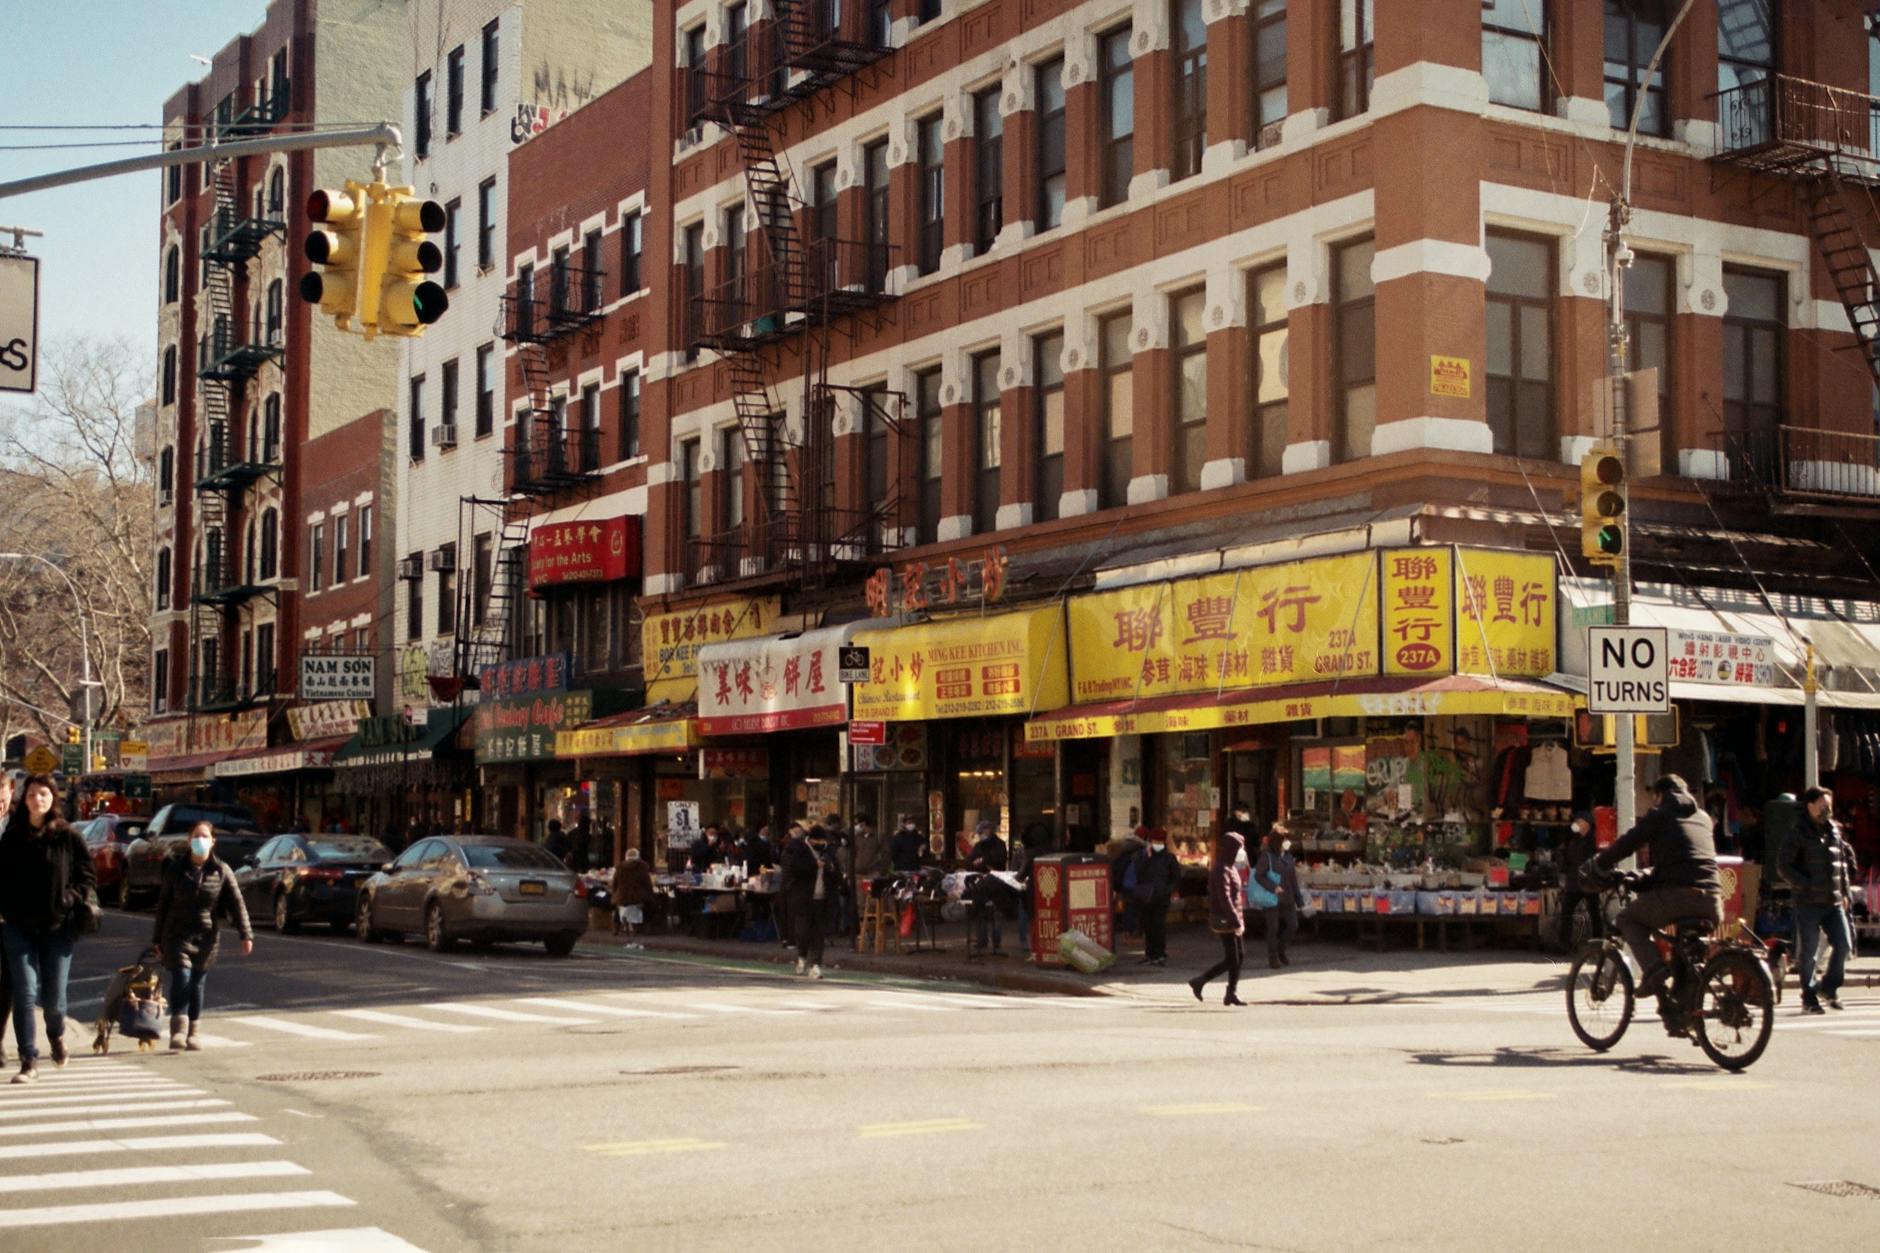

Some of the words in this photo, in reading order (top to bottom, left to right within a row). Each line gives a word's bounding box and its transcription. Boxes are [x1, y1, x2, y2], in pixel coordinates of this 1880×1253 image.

[571, 551, 592, 563] Arts
[1391, 555, 1442, 641] 聯豐行
[1461, 574, 1547, 627] 聯豐行
[1113, 584, 1322, 652] 聯豐行
[1328, 628, 1356, 650] 237A
[928, 648, 948, 662] MING
[950, 646, 968, 661] KEE
[969, 642, 1006, 658] KITCHEN
[1315, 653, 1353, 674] GRAND
[1357, 650, 1373, 670] ST.
[1399, 648, 1437, 664] 237A
[1602, 637, 1655, 669] NO
[305, 661, 337, 673] NAM
[1593, 681, 1665, 702] TURNS
[1030, 726, 1049, 738] 237A
[1055, 724, 1084, 736] GRAND
[675, 809, 691, 830] $1
[1038, 920, 1060, 938] LOVE
